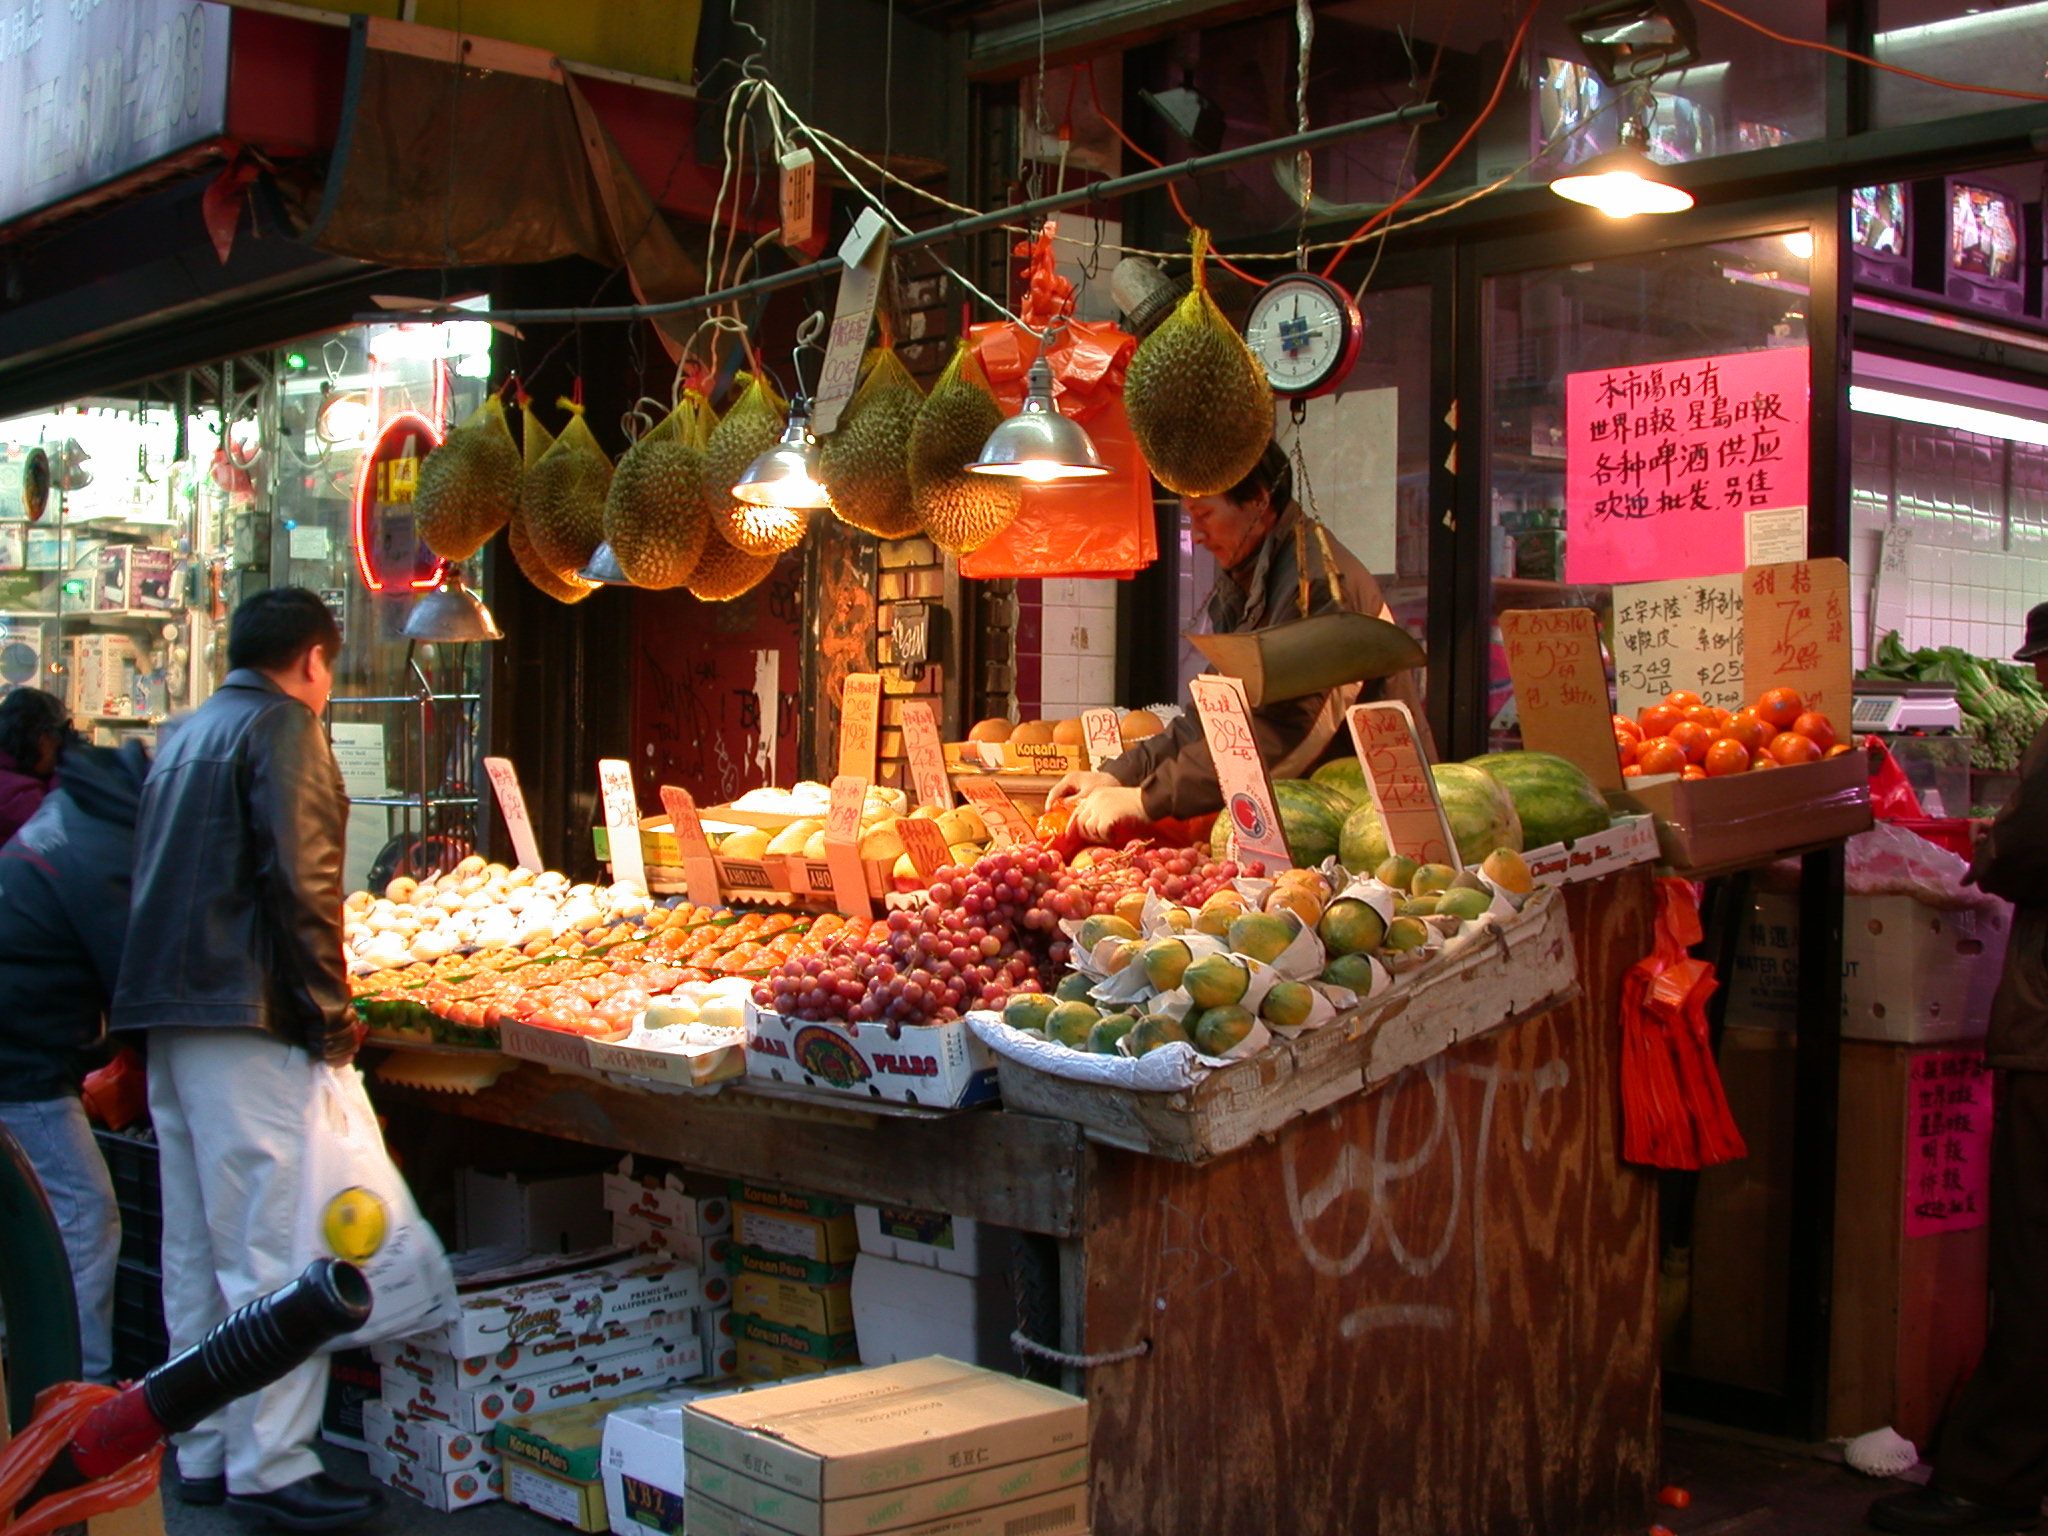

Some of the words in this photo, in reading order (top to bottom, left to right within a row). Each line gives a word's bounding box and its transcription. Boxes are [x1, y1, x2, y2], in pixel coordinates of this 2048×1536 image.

[1016, 743, 1057, 757] Korean
[1034, 757, 1069, 774] pears
[725, 867, 773, 888] VICTORY
[872, 1053, 938, 1076] PEARS
[742, 1254, 778, 1274] Korean
[611, 1295, 661, 1313] CALIFORNIA
[662, 1288, 688, 1303] FRUIT
[630, 1285, 670, 1299] PREMIUM
[745, 1323, 780, 1345] Korean
[948, 1448, 989, 1468] 毛豆仁
